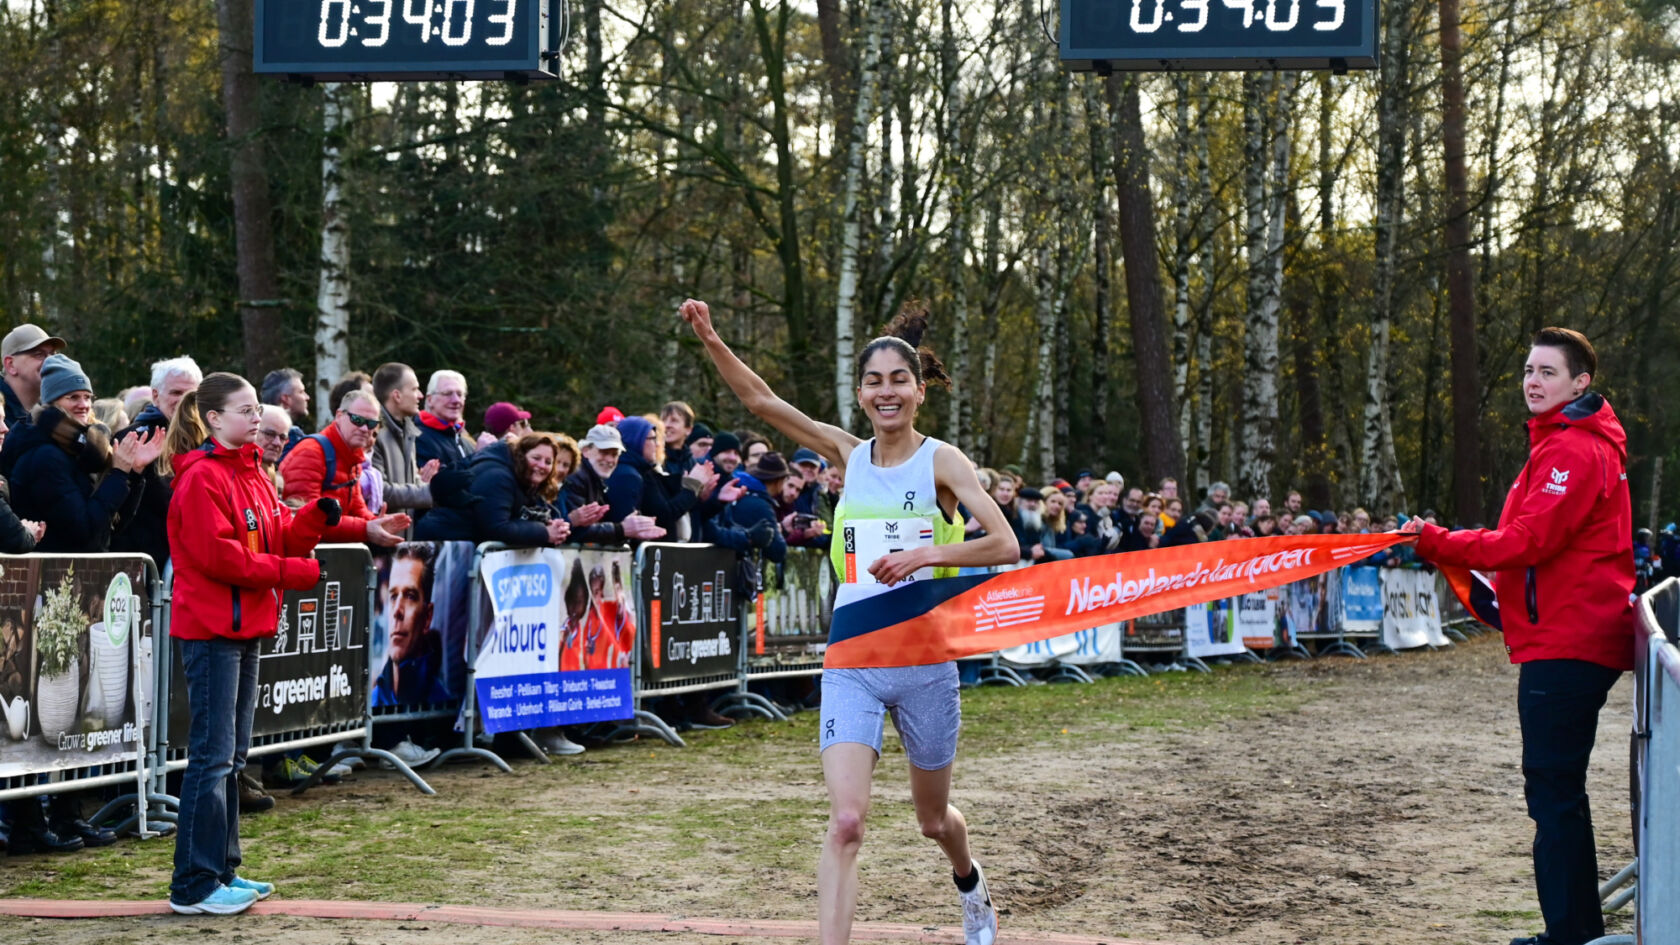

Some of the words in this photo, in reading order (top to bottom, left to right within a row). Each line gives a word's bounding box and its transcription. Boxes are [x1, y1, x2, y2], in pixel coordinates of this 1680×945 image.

[263, 683, 271, 708] a
[273, 675, 327, 714] greener
[329, 663, 351, 698] life.
[58, 731, 80, 751] Grow
[80, 733, 86, 749] a
[87, 728, 122, 752] greener
